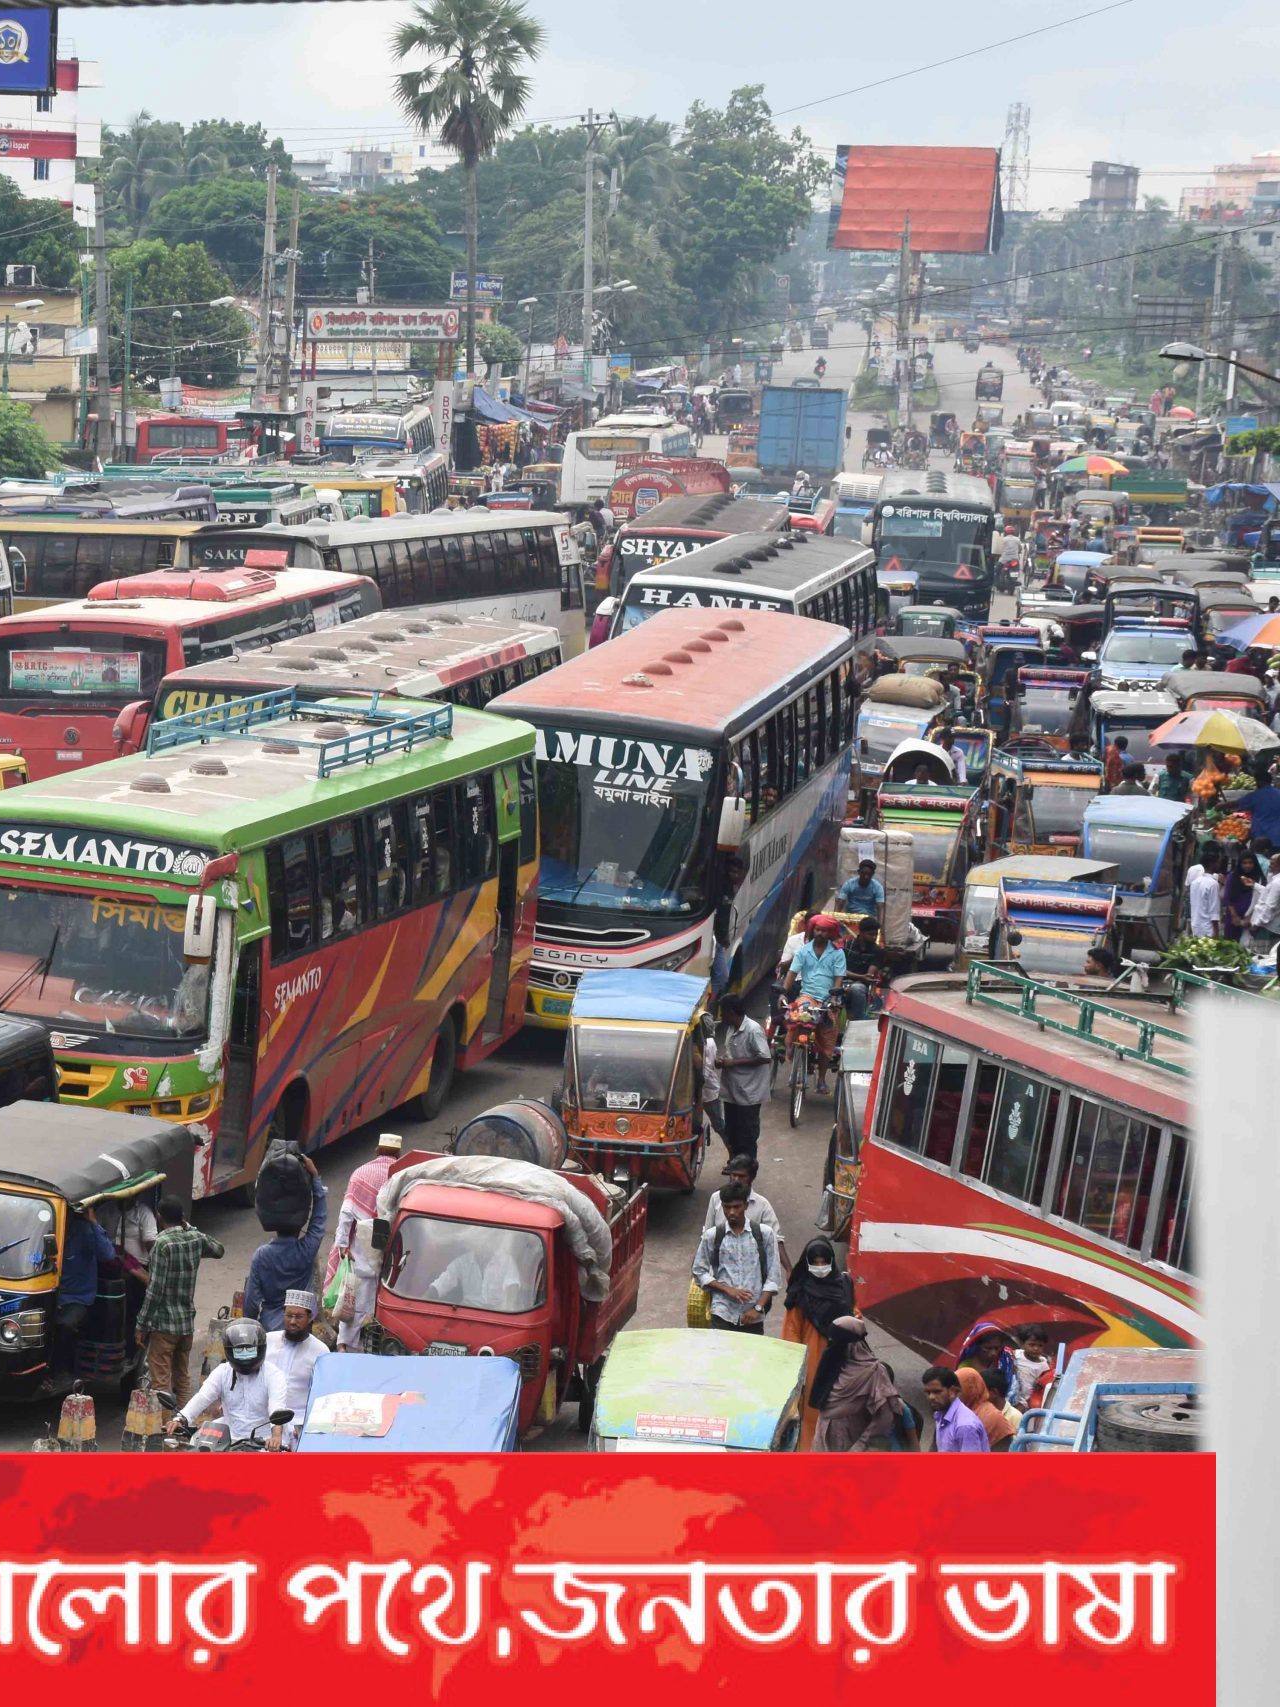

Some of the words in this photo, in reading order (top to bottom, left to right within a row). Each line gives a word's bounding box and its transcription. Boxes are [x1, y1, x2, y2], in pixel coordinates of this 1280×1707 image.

[13, 140, 29, 150] ispat
[216, 512, 257, 524] RFI
[895, 506, 931, 519] বরিশাল
[933, 507, 989, 524] বিশ্ববিদ্যালয়
[204, 549, 247, 560] SAKU
[535, 728, 704, 781] AMUNA
[593, 769, 677, 792] LINE
[592, 785, 630, 803] যমুনা
[630, 789, 673, 809] লাইন
[0, 829, 175, 874] SEMANTO
[533, 947, 608, 964] EGACY
[274, 966, 322, 1013] SEMANTO
